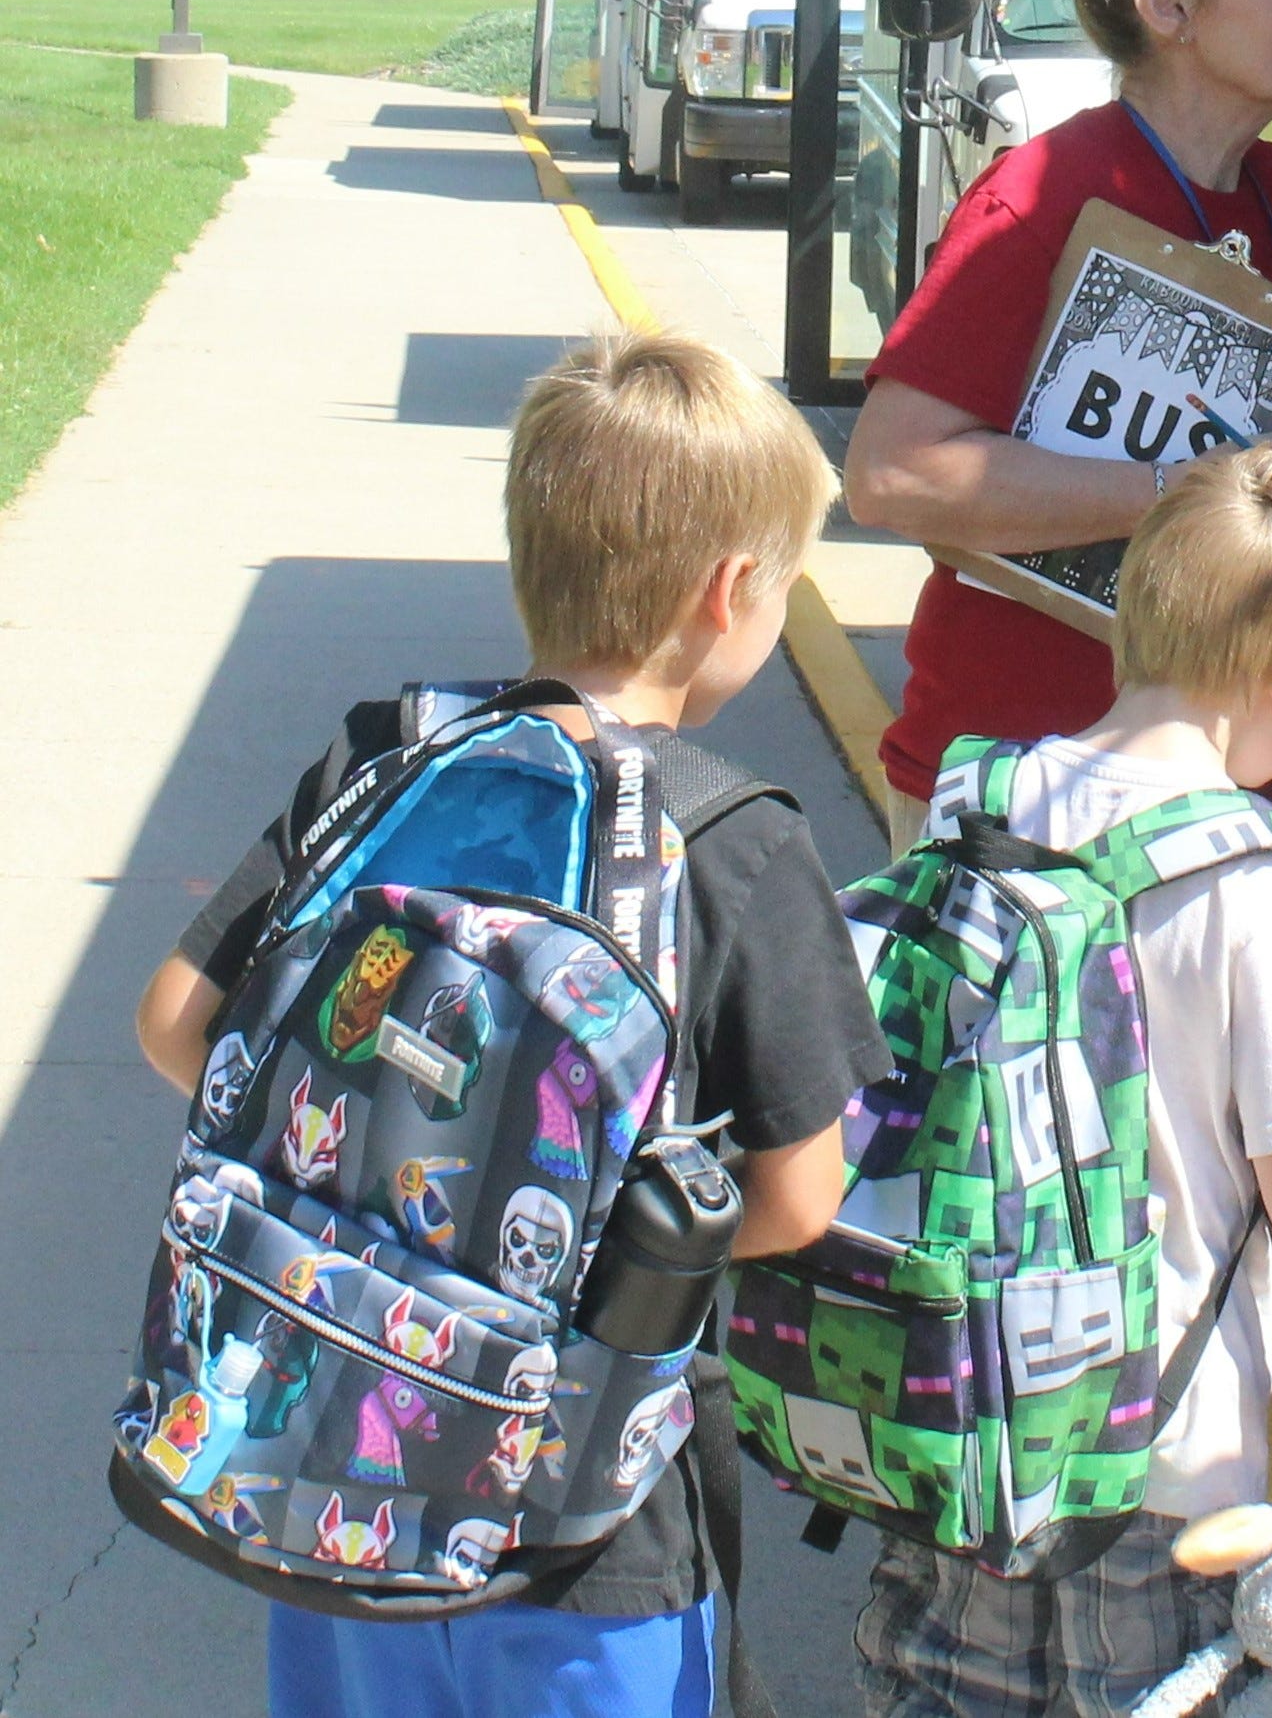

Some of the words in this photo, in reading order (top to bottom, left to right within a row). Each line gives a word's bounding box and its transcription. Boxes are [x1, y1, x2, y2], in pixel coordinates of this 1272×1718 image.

[1140, 274, 1203, 312] KABOOM
[301, 767, 377, 857] FORTNITE
[613, 747, 646, 859] FORTNITE
